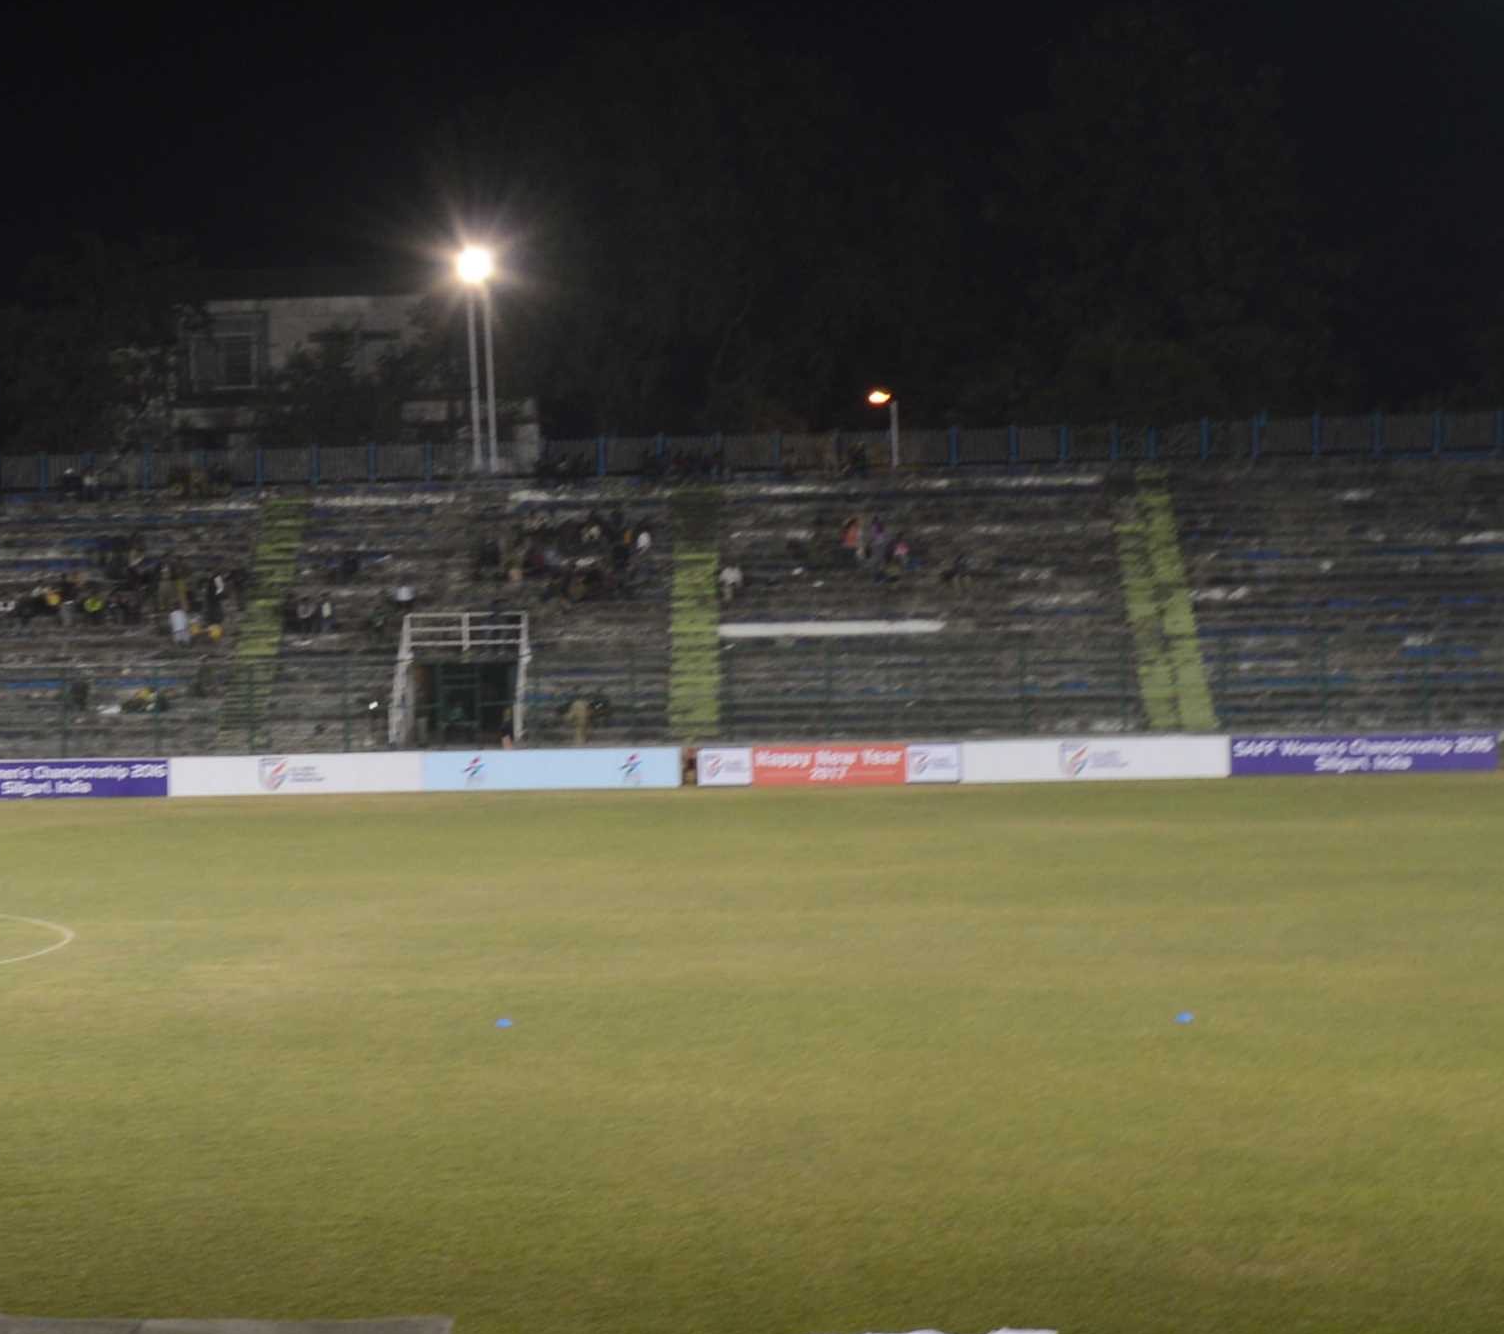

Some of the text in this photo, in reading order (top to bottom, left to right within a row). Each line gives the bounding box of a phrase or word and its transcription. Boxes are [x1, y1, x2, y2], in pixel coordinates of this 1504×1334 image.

[754, 751, 812, 768] Happy
[815, 750, 858, 765] New
[860, 749, 902, 765] Year
